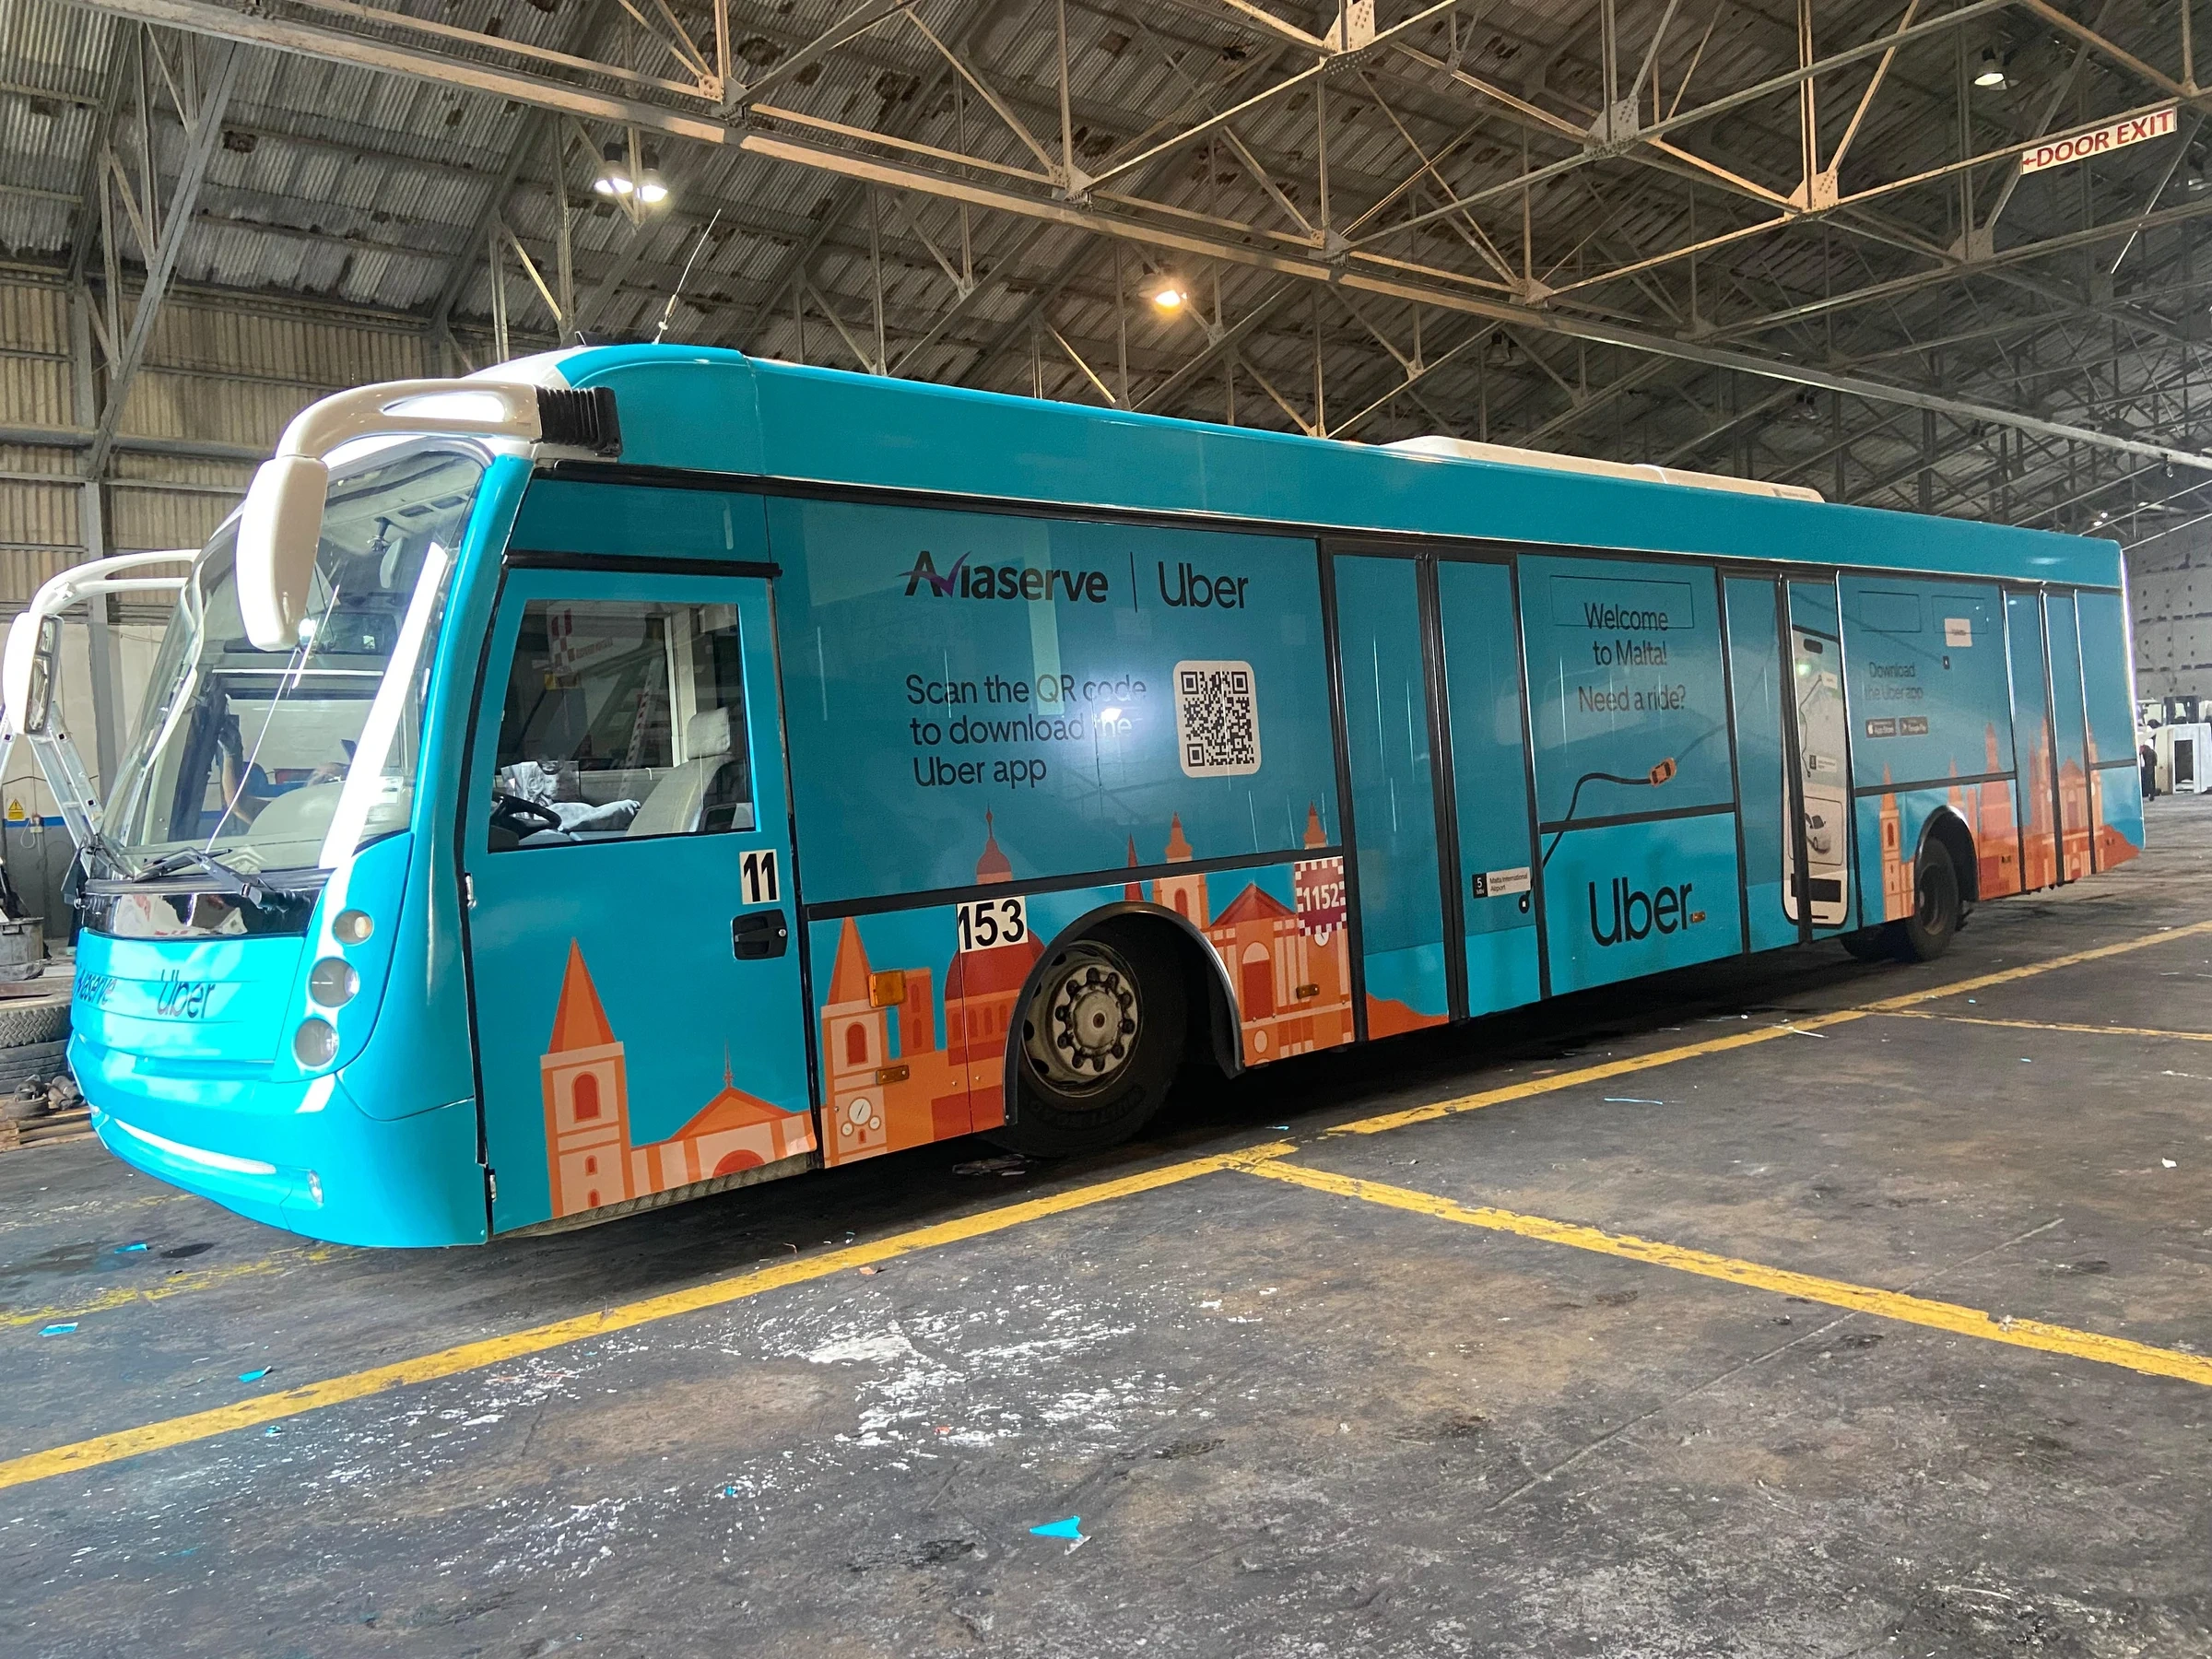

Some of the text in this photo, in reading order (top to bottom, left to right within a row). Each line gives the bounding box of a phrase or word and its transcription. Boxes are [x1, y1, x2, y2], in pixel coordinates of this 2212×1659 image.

[2037, 111, 2173, 167] DOOR EXIT
[1158, 560, 1249, 609] Uber
[1583, 602, 1669, 631] Welcome
[1593, 639, 1667, 665] to Malta!
[1868, 661, 1916, 678] Download
[906, 674, 1147, 704] Scan the QR code
[1578, 684, 1686, 712] Need a ride?
[910, 709, 1133, 745] to download he
[913, 756, 1047, 789] Uber app
[743, 852, 777, 902] 11
[1477, 877, 1483, 888] 5
[1303, 883, 1340, 912] 1152
[1588, 877, 1693, 947] Uber
[958, 899, 1025, 950] 153
[157, 969, 217, 1019] Uber
